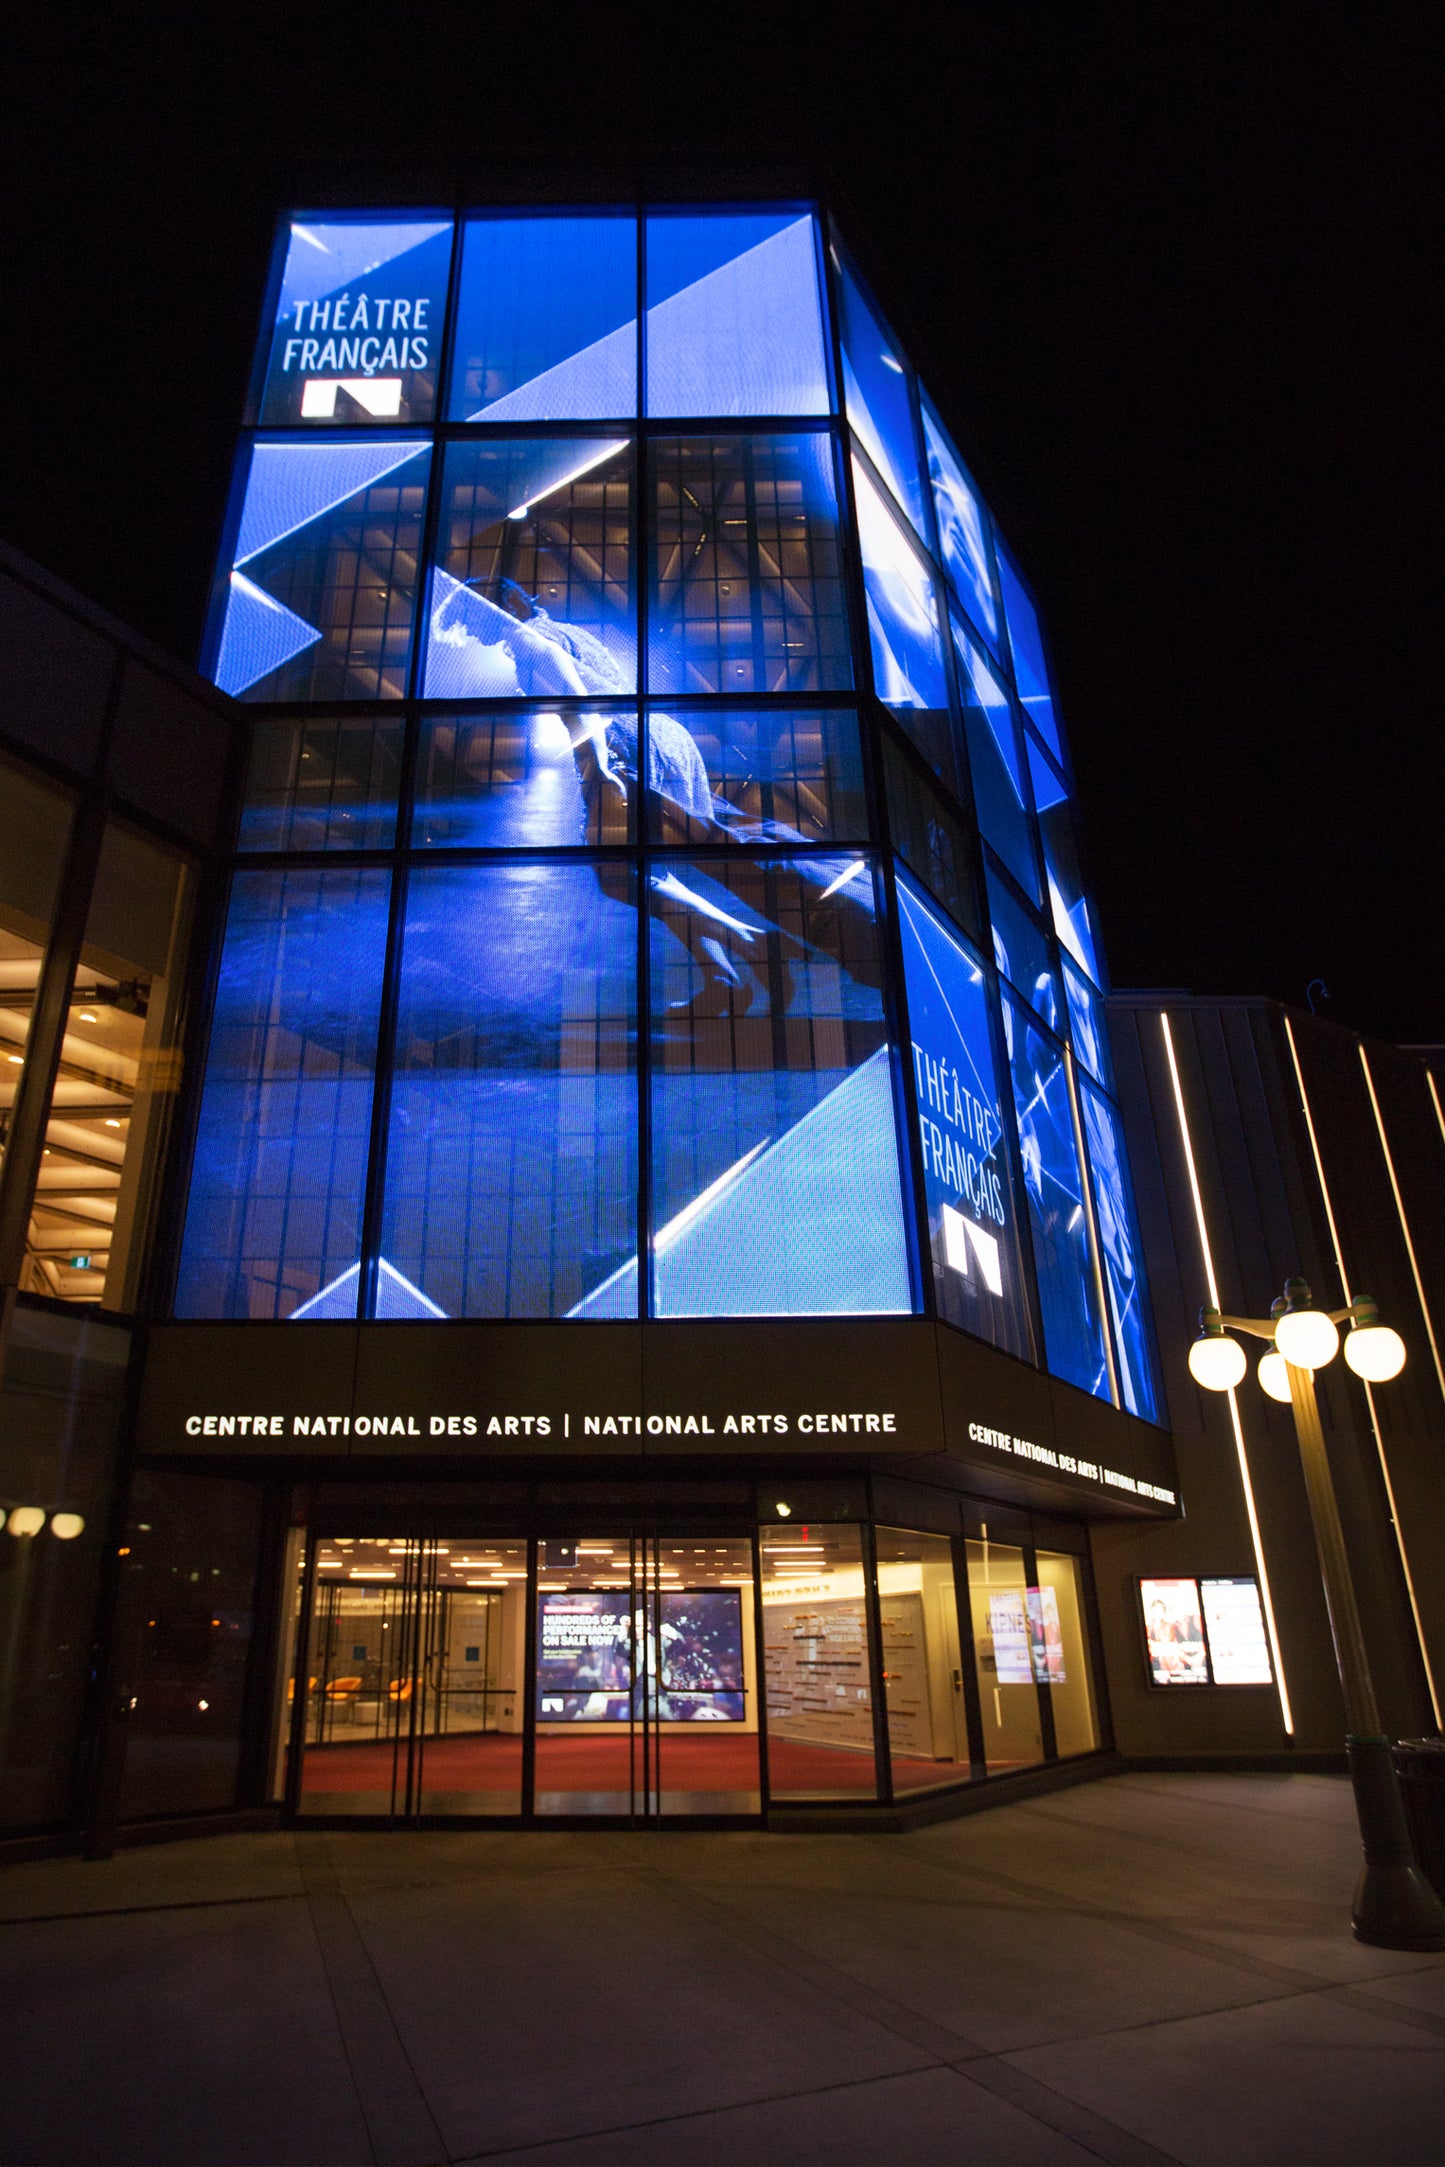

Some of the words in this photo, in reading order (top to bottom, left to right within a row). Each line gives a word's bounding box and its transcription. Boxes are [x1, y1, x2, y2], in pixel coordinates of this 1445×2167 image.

[293, 292, 430, 332] THÉÂTRE
[282, 337, 429, 377] FRANÇAIS
[911, 1040, 997, 1162] THÉÂTRE
[919, 1112, 1006, 1227] FRANÇAIS
[185, 1415, 285, 1436] CENTRE
[292, 1416, 421, 1436] NATIONAL
[429, 1415, 478, 1436] DES
[486, 1415, 552, 1436] ARTS
[584, 1415, 716, 1435] NATIONAL
[722, 1414, 789, 1434] ARTS
[797, 1413, 897, 1433] CENTRE
[968, 1423, 1012, 1452] CENTRE
[1013, 1438, 1059, 1468] NATIONAL
[1058, 1454, 1077, 1473] DES
[1077, 1460, 1099, 1480] ARTS
[1104, 1469, 1137, 1493] NATIONAL
[1137, 1480, 1154, 1498] ARTS
[1153, 1485, 1176, 1505] CENTRE
[543, 1615, 600, 1626] HUNDREDS
[600, 1615, 617, 1626] OF
[542, 1636, 560, 1646] ON
[560, 1636, 587, 1646] SALE
[587, 1636, 614, 1646] NOW
